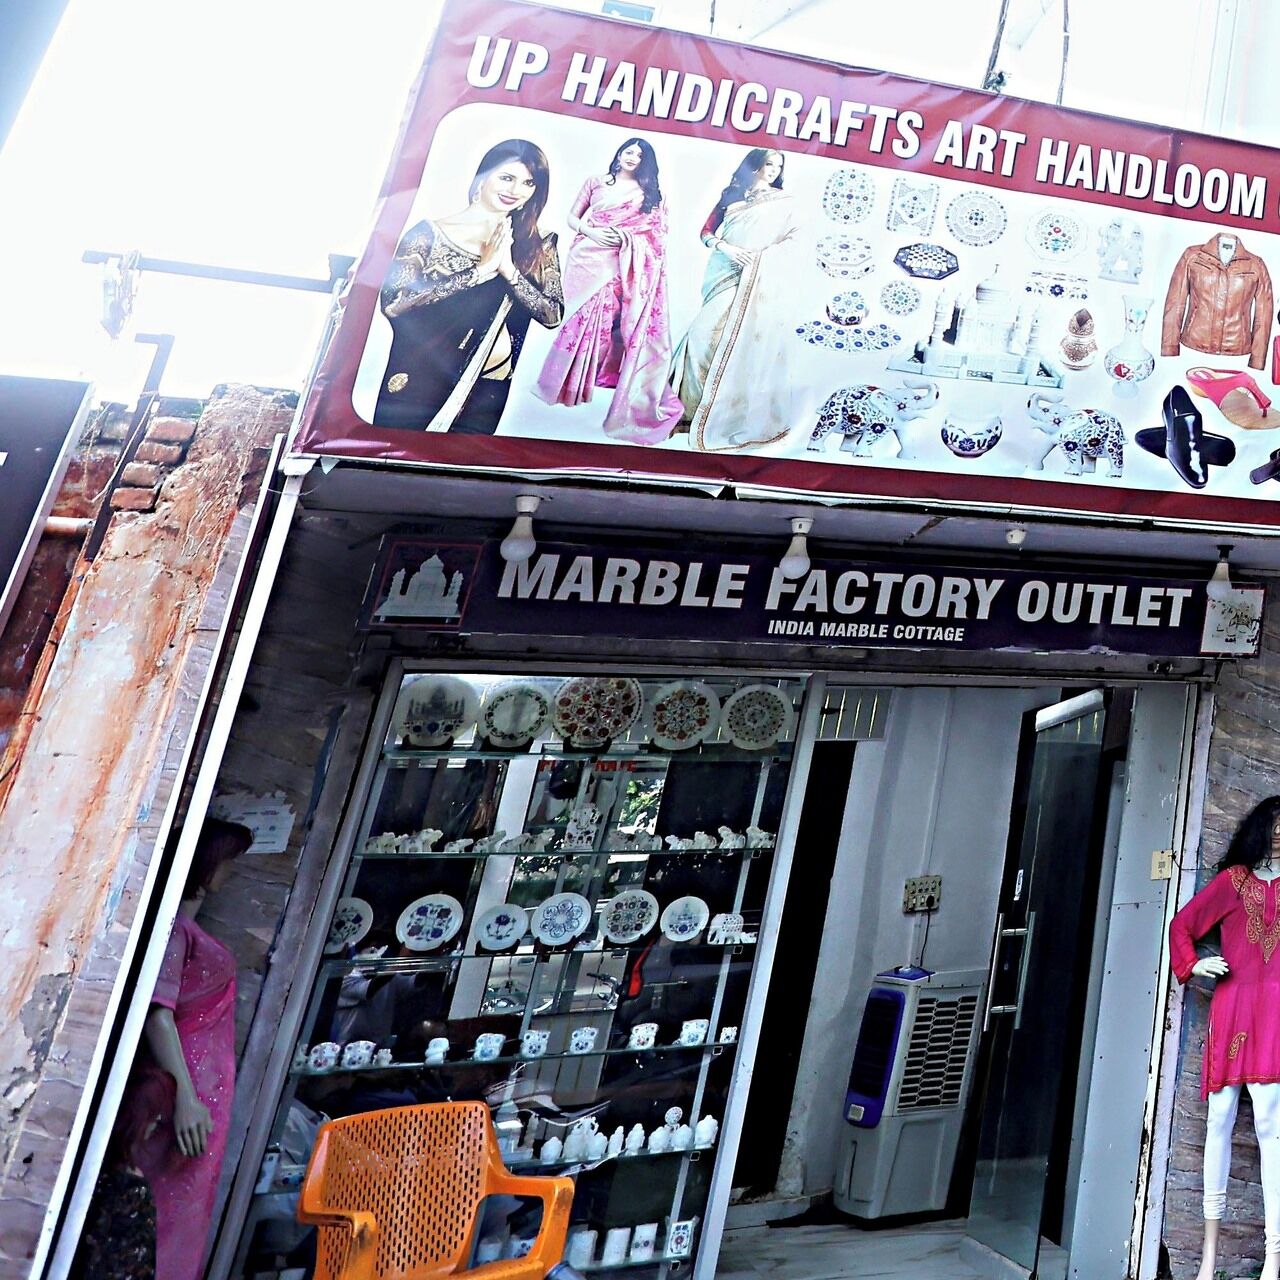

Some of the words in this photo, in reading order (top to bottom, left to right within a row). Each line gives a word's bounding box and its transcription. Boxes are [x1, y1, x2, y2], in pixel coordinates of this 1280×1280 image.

[466, 34, 551, 92] UP
[560, 54, 926, 161] HANDICRAFTS
[933, 118, 1027, 178] ART
[1034, 136, 1268, 221] HANDLOOM
[497, 551, 748, 612] MARBLE
[766, 567, 1005, 623] FACTORY
[1015, 580, 1194, 631] OUTLET
[767, 619, 814, 639] INDIA
[818, 622, 890, 641] MARBLE
[893, 624, 966, 644] COTTAGE
